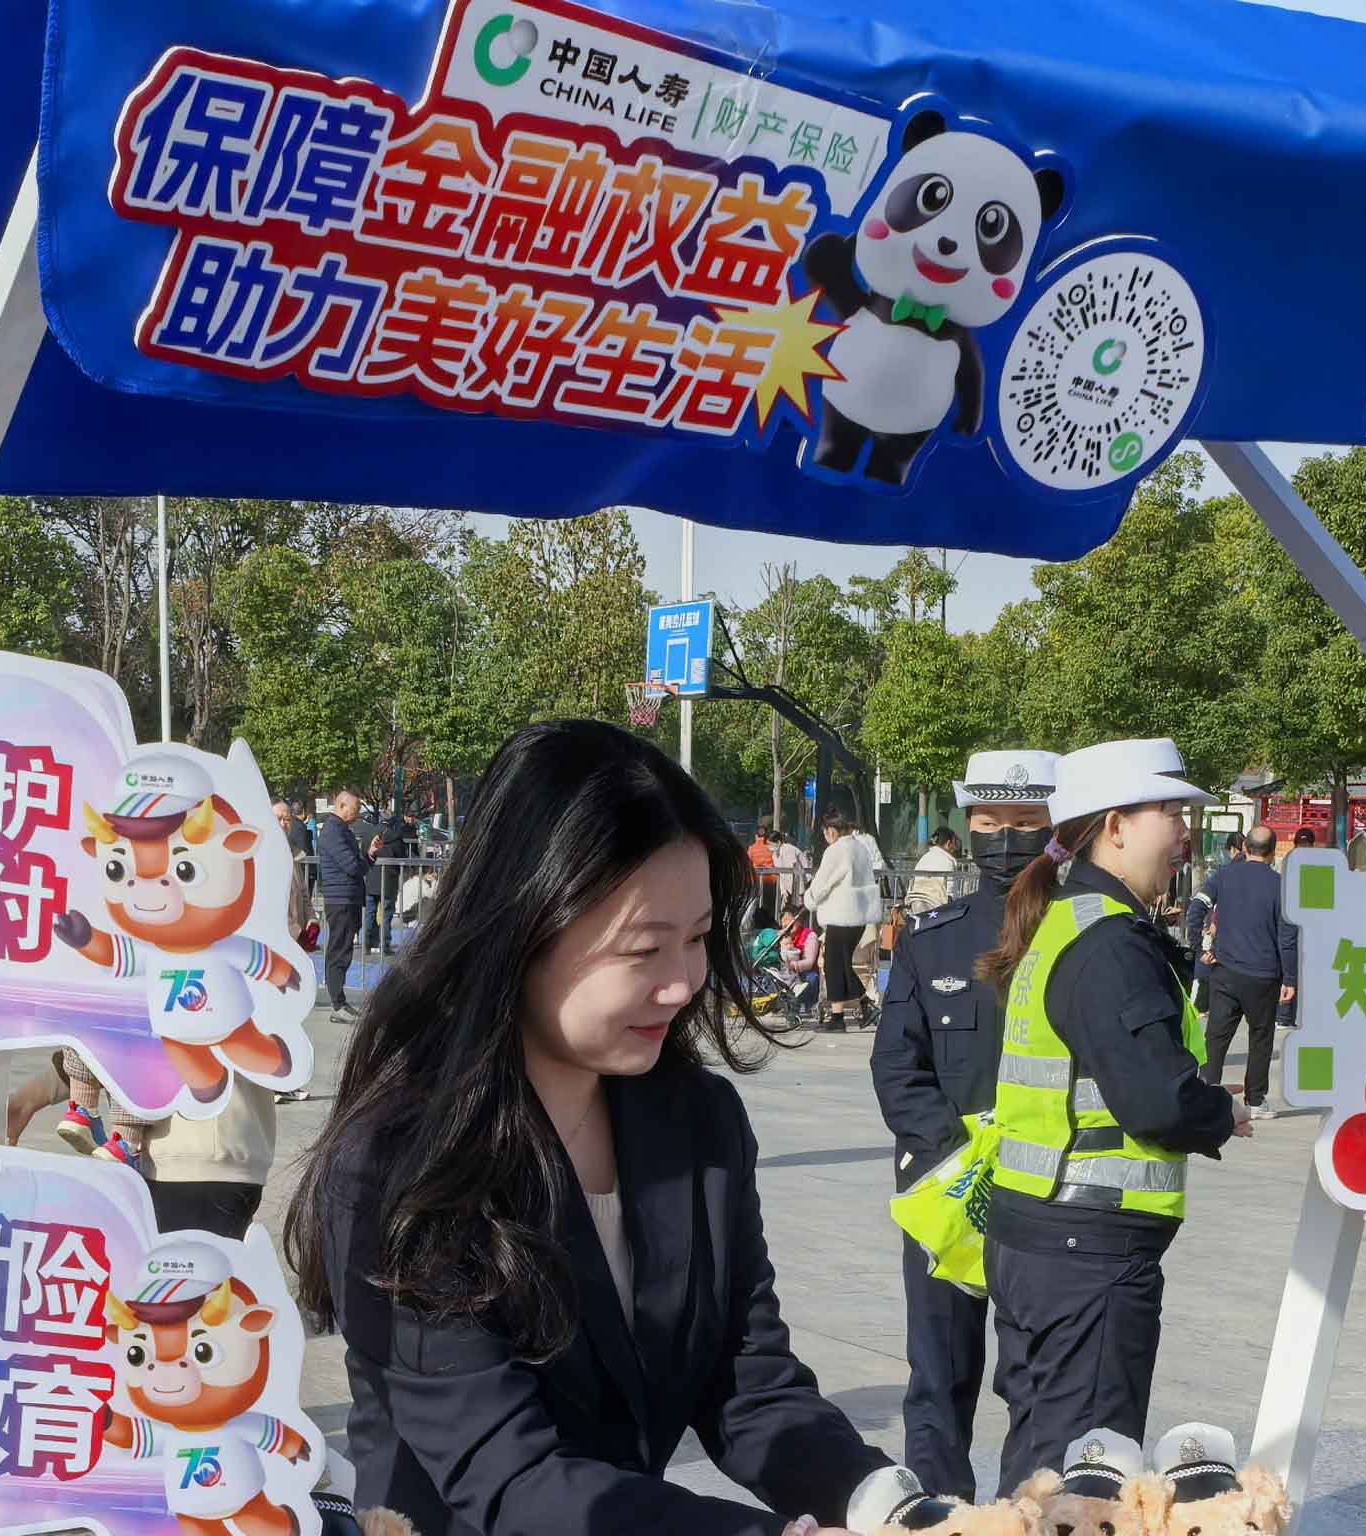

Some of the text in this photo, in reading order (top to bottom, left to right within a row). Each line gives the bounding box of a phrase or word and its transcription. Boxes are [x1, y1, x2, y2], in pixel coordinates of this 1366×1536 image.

[548, 38, 691, 109] 中国人寿
[539, 78, 678, 133] CHINA LIFE
[713, 96, 859, 175] 财产保险
[129, 71, 817, 305] 保障金融权益
[155, 244, 781, 433] 助力美好生活
[1068, 389, 1114, 408] CHINA LIFE
[1072, 376, 1119, 398] 中国人寿
[160, 969, 208, 1013] 75
[176, 1446, 222, 1489] 75
